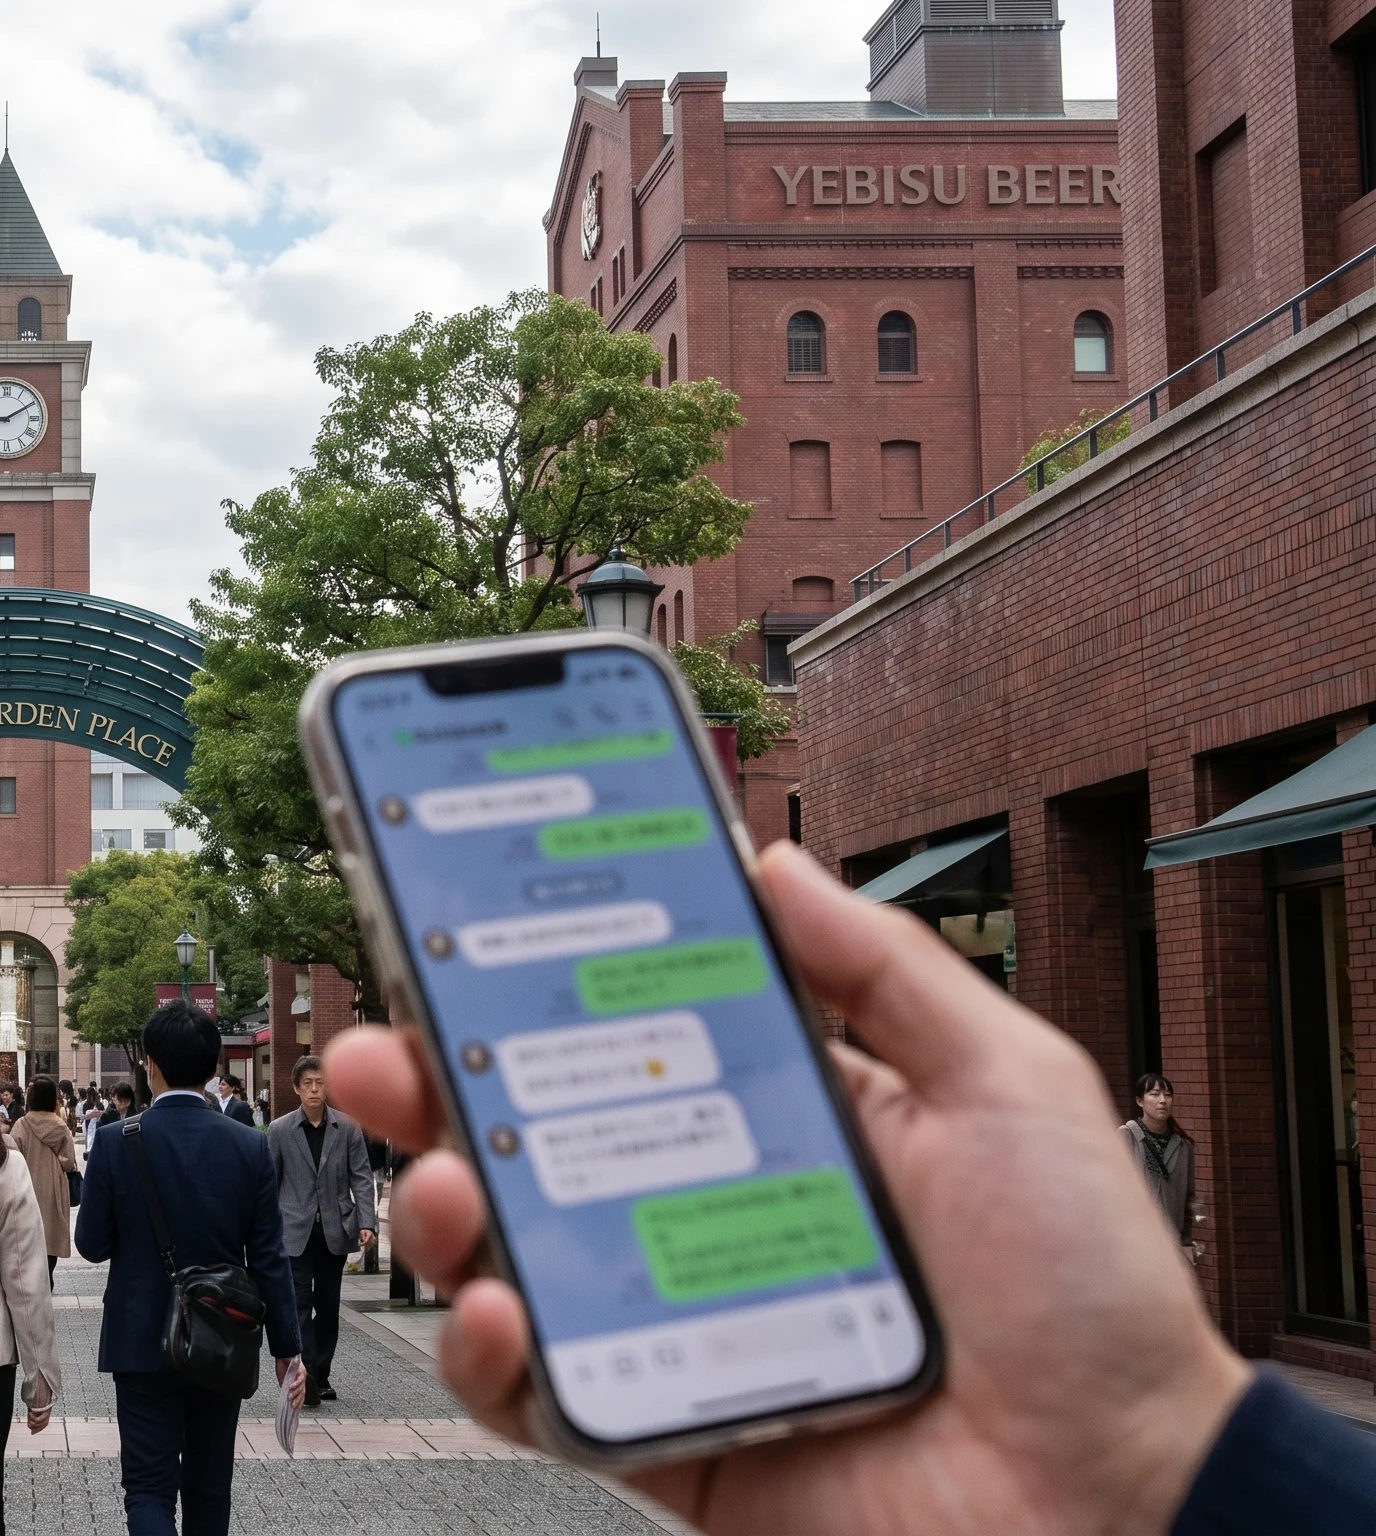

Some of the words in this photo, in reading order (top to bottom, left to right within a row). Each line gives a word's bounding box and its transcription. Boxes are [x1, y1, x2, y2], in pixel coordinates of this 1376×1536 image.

[772, 164, 966, 205] YEBISU
[987, 164, 1122, 205] BEER
[85, 712, 176, 767] PLACE
